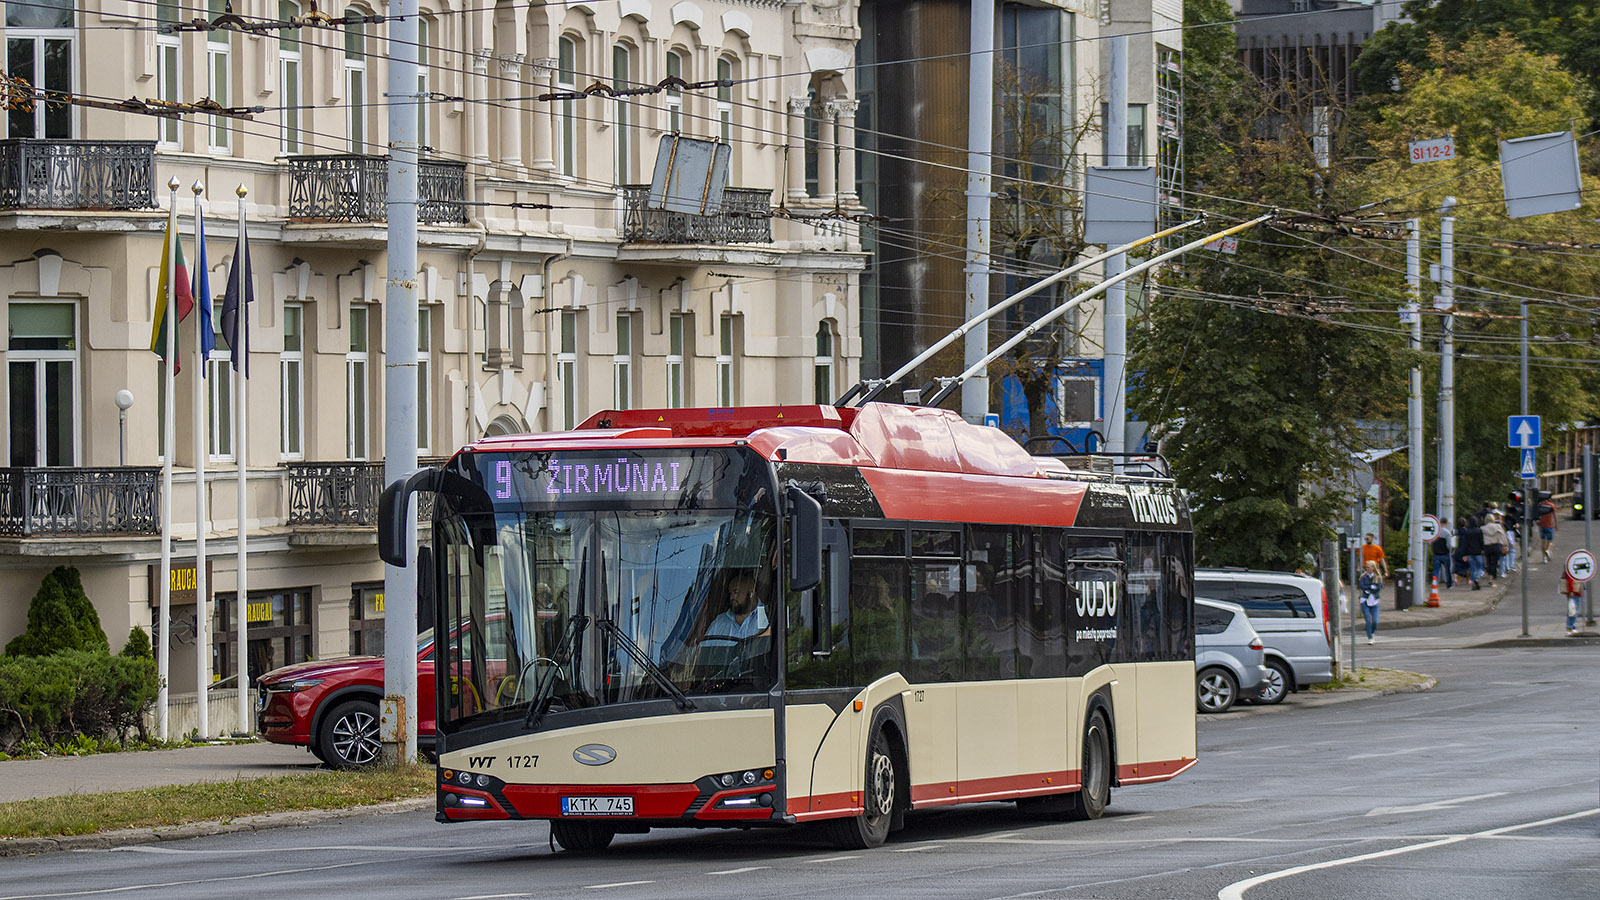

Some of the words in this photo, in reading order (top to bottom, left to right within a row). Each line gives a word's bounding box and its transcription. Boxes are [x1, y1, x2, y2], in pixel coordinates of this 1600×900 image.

[495, 460, 512, 499] 9
[546, 457, 680, 494] ŽIRMŪNAI
[1126, 485, 1177, 525] VILNIUS
[170, 567, 198, 591] RAUGA
[1075, 580, 1117, 618] JUDU
[247, 602, 273, 622] RAUGAI
[914, 690, 925, 702] 1727
[506, 755, 540, 768] 1727
[570, 798, 599, 811] KTK
[607, 798, 631, 811] 745
